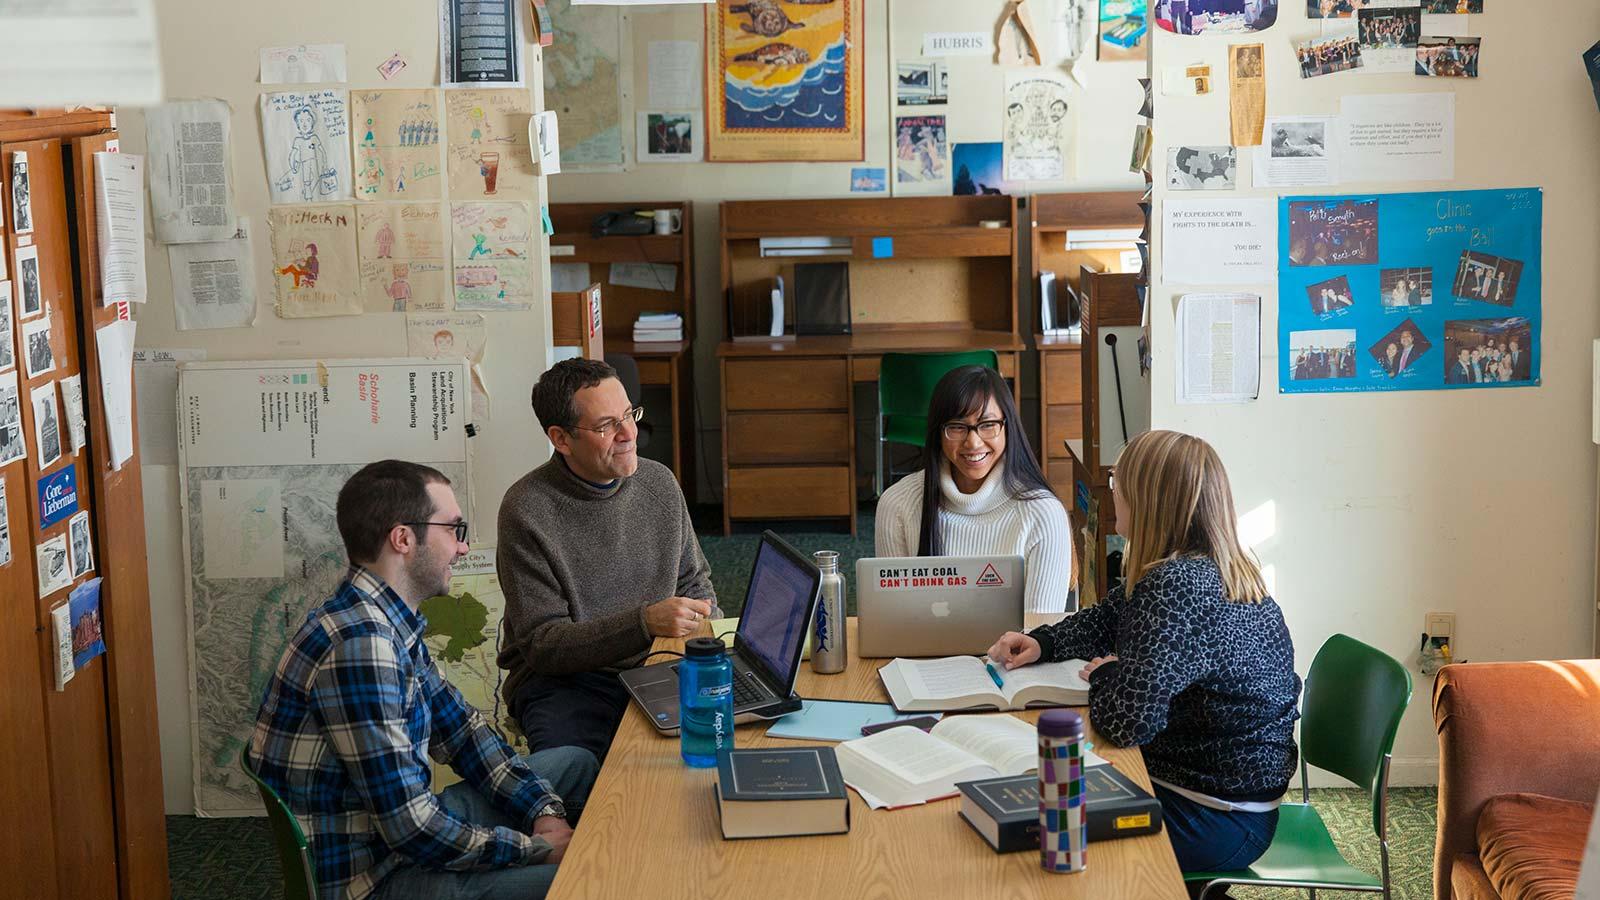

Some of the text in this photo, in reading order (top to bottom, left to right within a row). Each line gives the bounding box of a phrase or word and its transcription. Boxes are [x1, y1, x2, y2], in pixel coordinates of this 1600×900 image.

[933, 38, 983, 49] HUBRIS
[1436, 198, 1472, 220] Clinic
[1470, 224, 1495, 247] Ball
[358, 373, 368, 401] Basin
[370, 373, 380, 424] Schoharie
[409, 372, 418, 428] Basin Planning
[46, 484, 62, 500] Gore
[43, 492, 76, 517] Lieberman
[880, 567, 958, 578] CAN'T EAT COAL
[880, 576, 967, 588] CAN'T DRINK GAS
